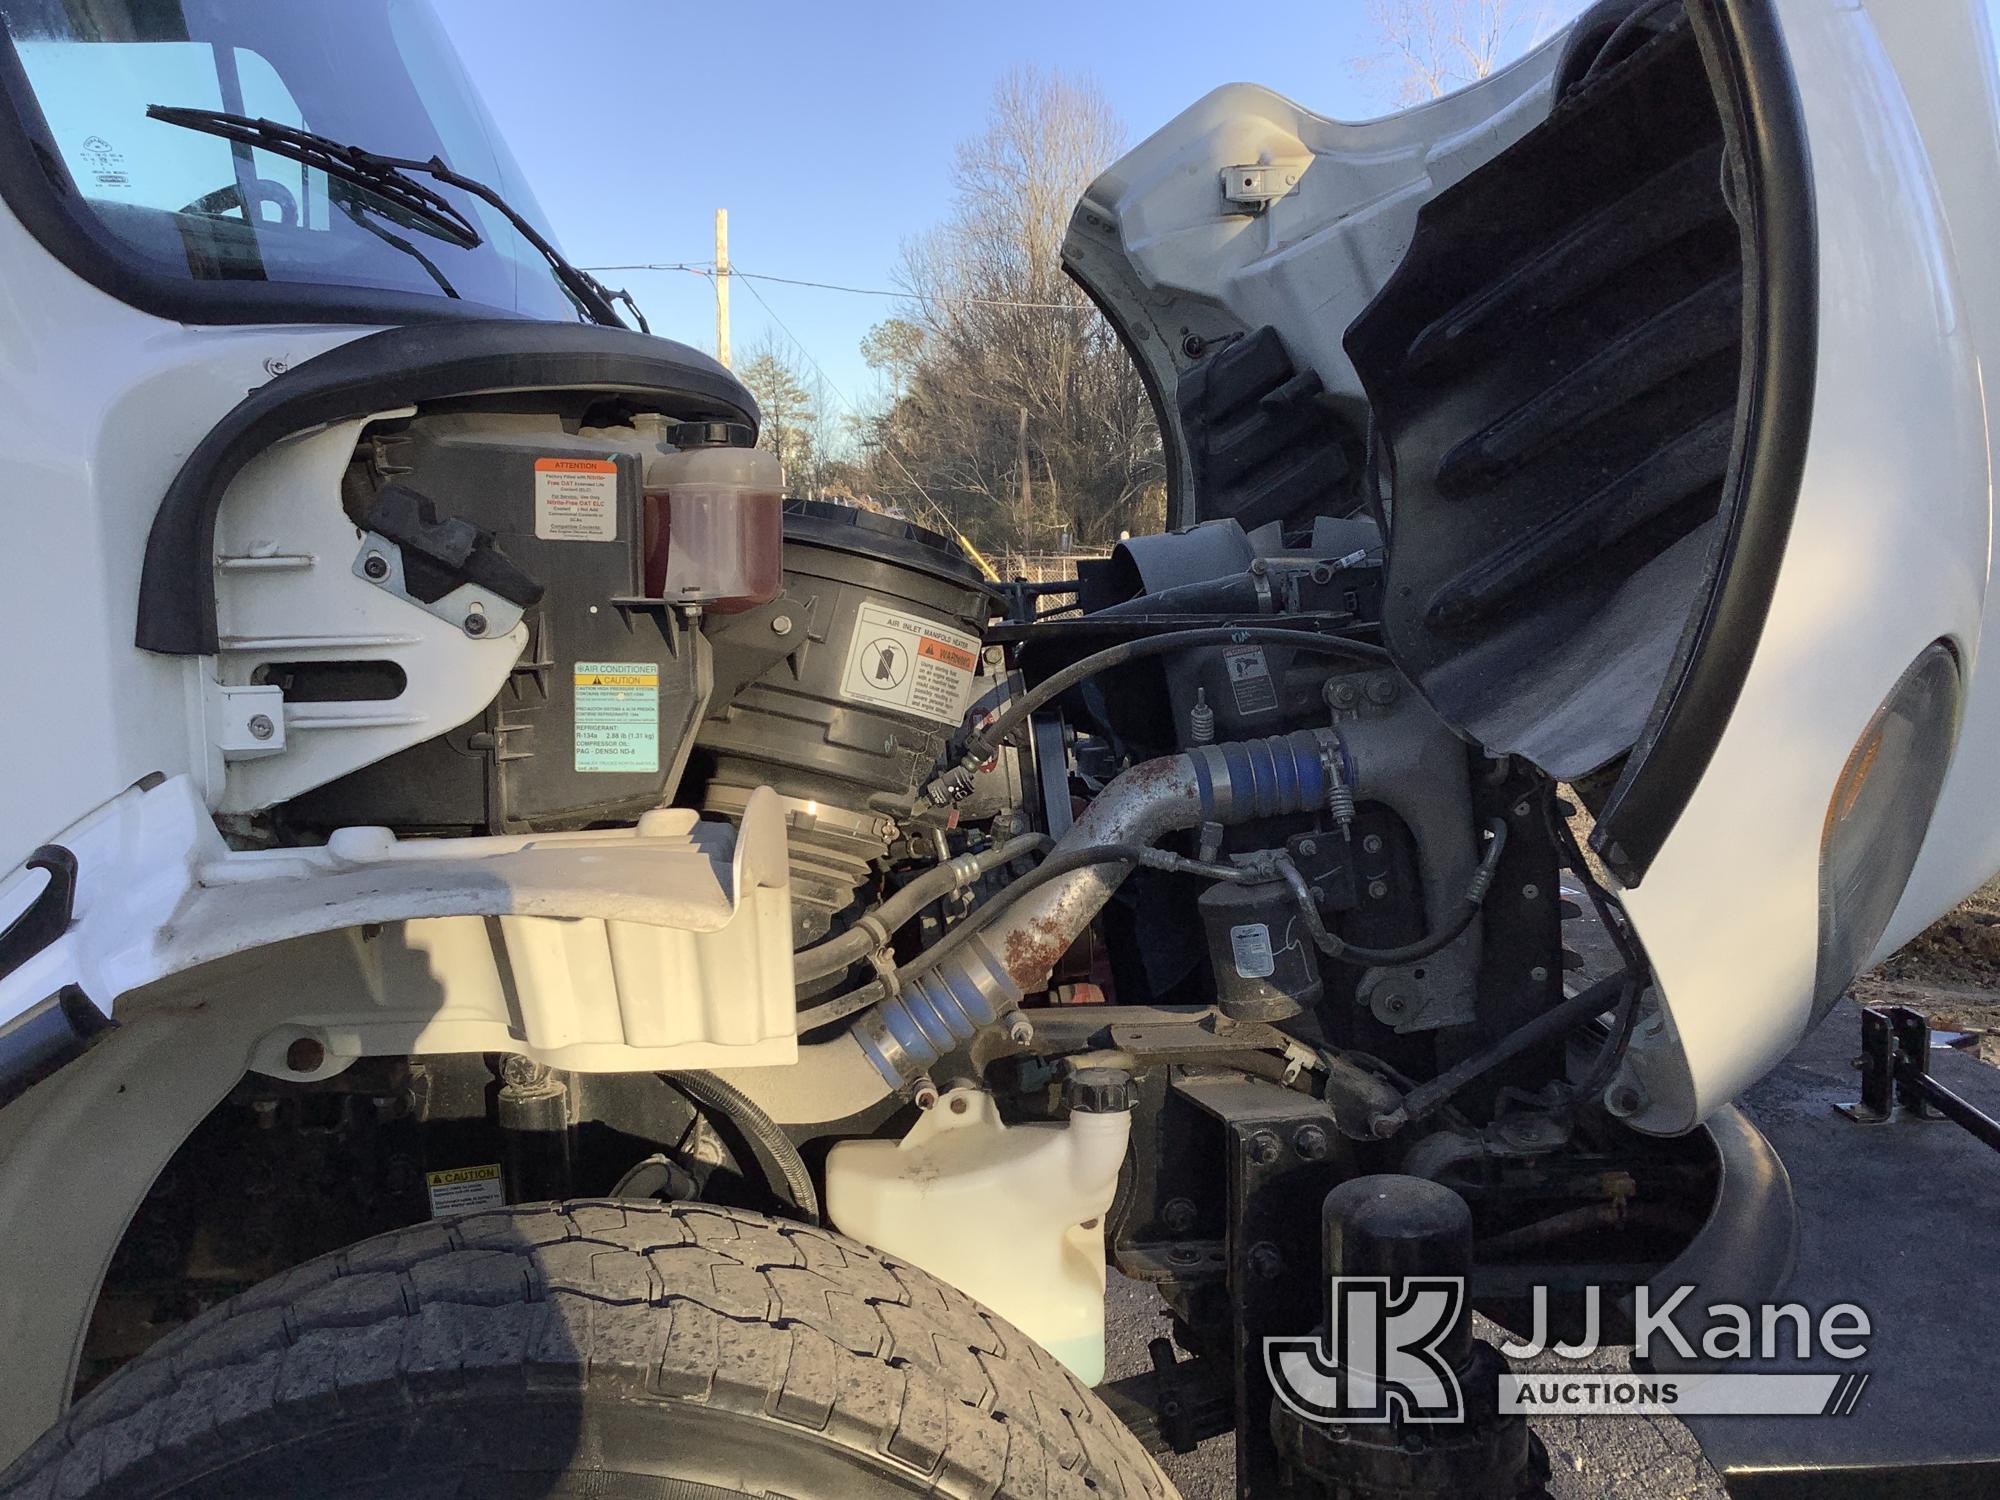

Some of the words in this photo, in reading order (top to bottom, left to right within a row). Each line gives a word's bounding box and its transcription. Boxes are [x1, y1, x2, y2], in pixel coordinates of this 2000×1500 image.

[886, 619, 900, 627] AIR
[902, 624, 921, 633] INLET
[924, 629, 951, 643] MANIFOLD
[952, 639, 969, 649] HEATER
[940, 648, 971, 667] WARNING
[444, 1168, 494, 1182] CAUTION
